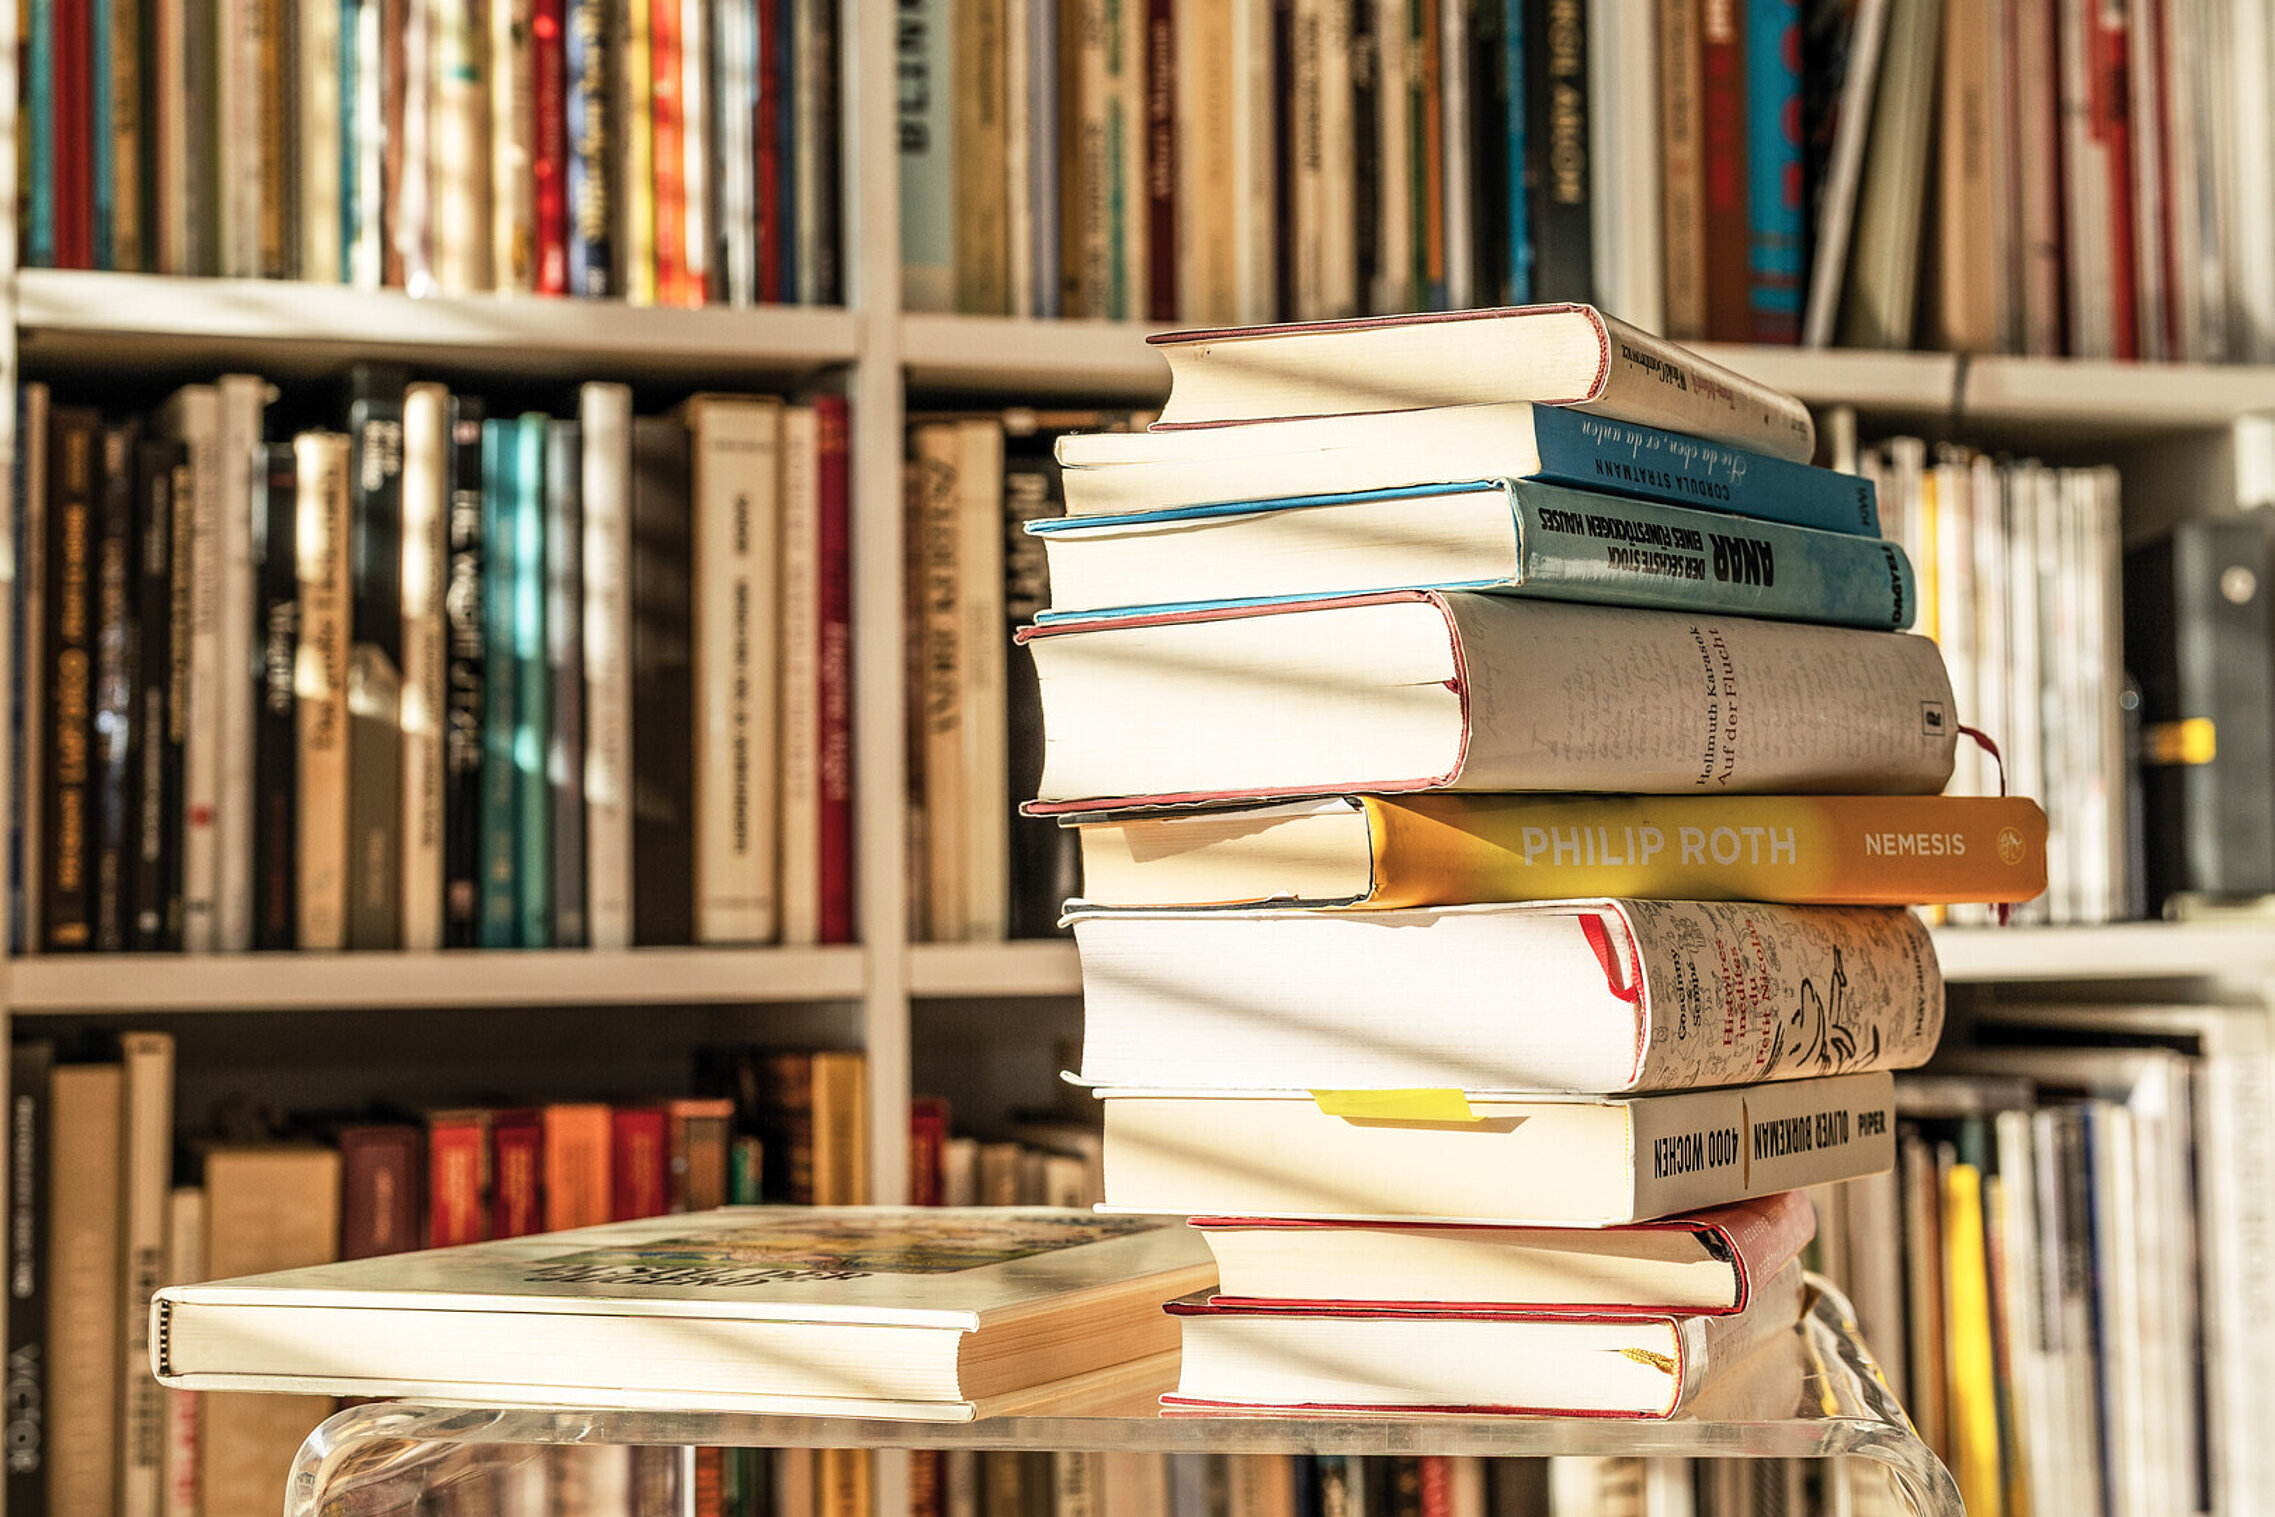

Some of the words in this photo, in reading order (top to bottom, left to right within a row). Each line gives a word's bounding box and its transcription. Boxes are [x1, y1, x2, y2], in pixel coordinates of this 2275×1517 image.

[1582, 420, 1622, 446] unten
[1626, 428, 1643, 460] da
[1646, 435, 1661, 449] er
[1595, 458, 1673, 489] STRATMANN
[1702, 452, 1718, 476] da
[1720, 454, 1747, 486] Sie
[1675, 474, 1730, 501] CORDULA
[1538, 507, 1585, 535] HAUSES
[1585, 514, 1673, 550] FÜNFSTÖCKIGEN
[1671, 527, 1704, 551] EINES
[1607, 546, 1641, 572] STOCK
[1641, 550, 1683, 578] SECHSTE
[1685, 556, 1706, 580] DER
[1708, 533, 1775, 587] ANAR
[1881, 545, 1903, 624] DAGYELI
[1690, 624, 1718, 697] Karasek
[1709, 628, 1737, 697] Flucht
[1725, 701, 1738, 741] der
[1696, 703, 1718, 785] Hellmuth
[1718, 745, 1736, 786] Auf
[1521, 826, 1665, 867] PHILIP
[1679, 826, 1797, 867] ROTH
[1865, 833, 1966, 856] NEMESIS
[1746, 919, 1771, 1001] Nicolas
[1671, 949, 1687, 1040] Goscinny
[1687, 961, 1701, 1027] Sempé
[1716, 939, 1734, 1046] Histoires
[1730, 946, 1746, 1038] inédites
[1750, 978, 1758, 1007] du
[1756, 1011, 1771, 1064] Petit
[1754, 1115, 1812, 1160] BURKEMAN
[1815, 1110, 1849, 1148] OLIVER
[1858, 1110, 1887, 1138] PIPER
[1654, 1132, 1704, 1179] WOCHEN
[1708, 1127, 1739, 1168] 4000
